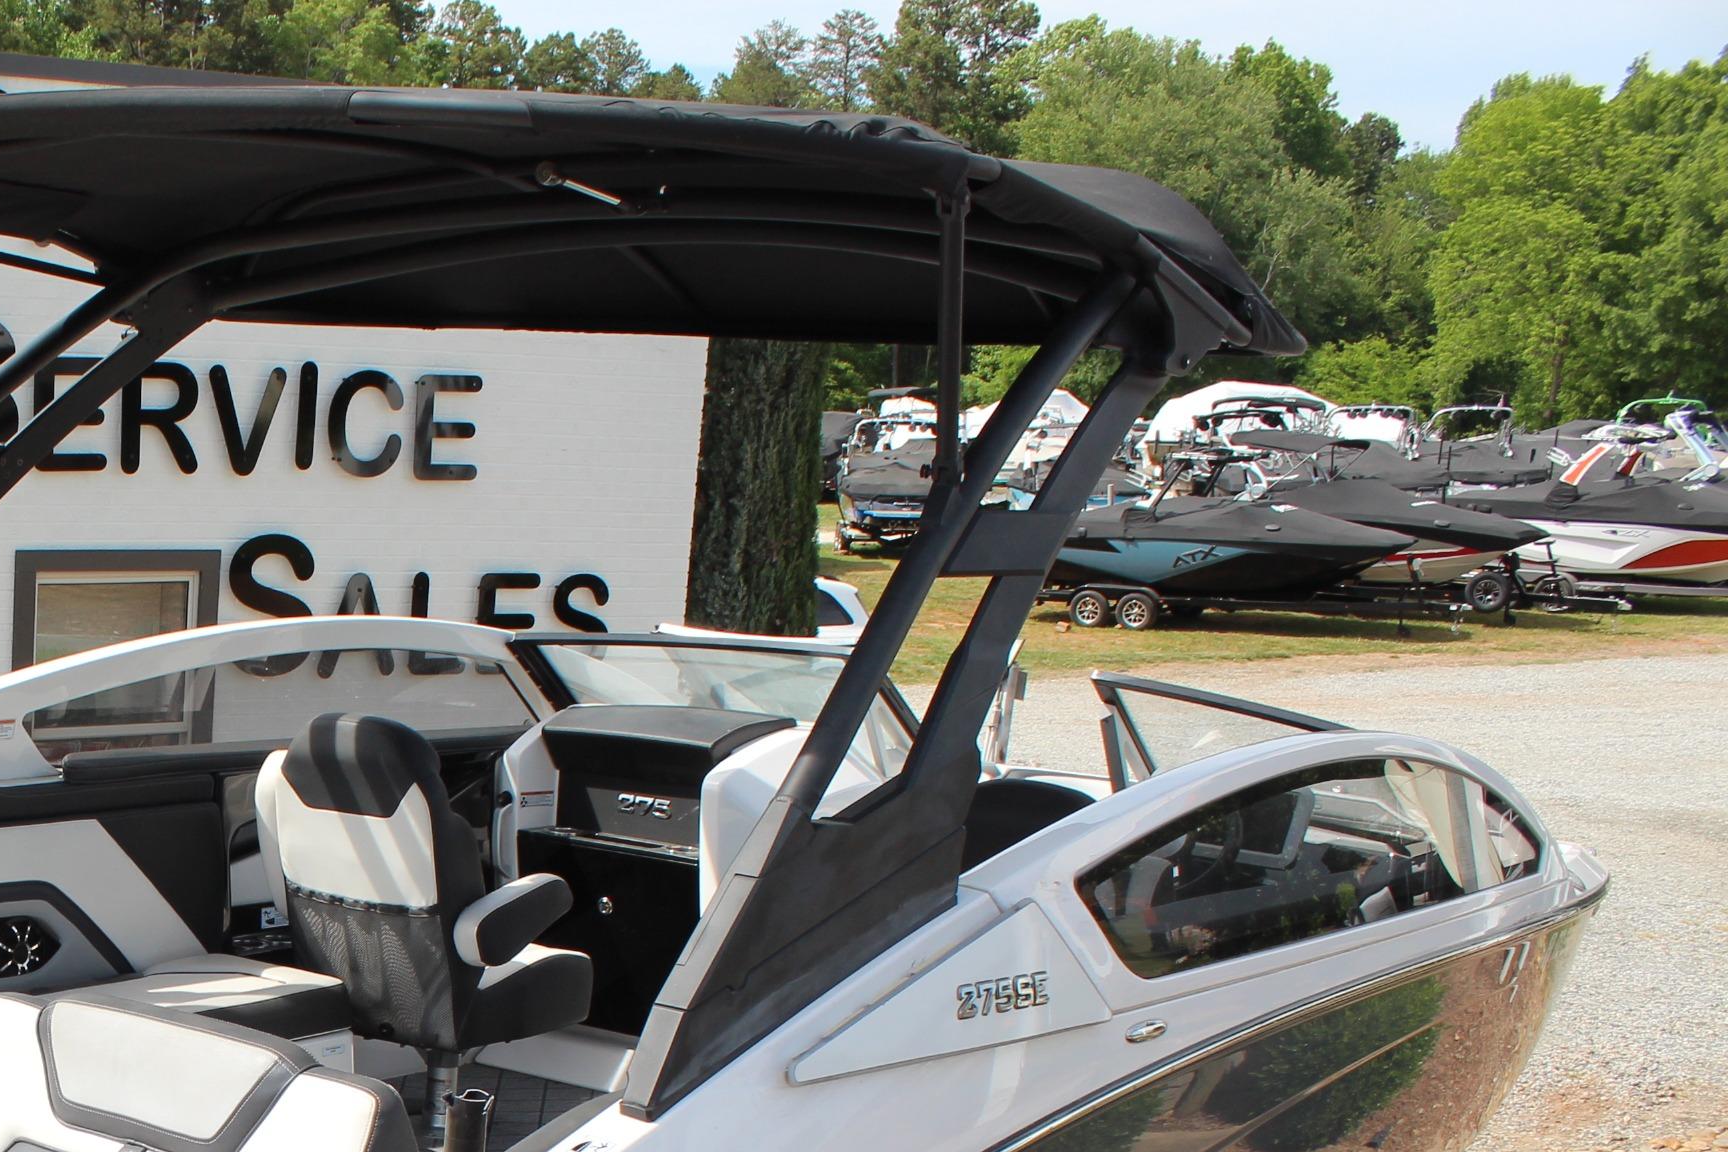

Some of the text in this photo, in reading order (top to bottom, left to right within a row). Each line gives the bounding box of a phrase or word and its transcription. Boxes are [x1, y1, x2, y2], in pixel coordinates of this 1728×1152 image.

[1173, 545, 1224, 569] ATX
[229, 532, 611, 679] SALES
[617, 792, 672, 821] 275
[956, 970, 1050, 1020] 275SE
